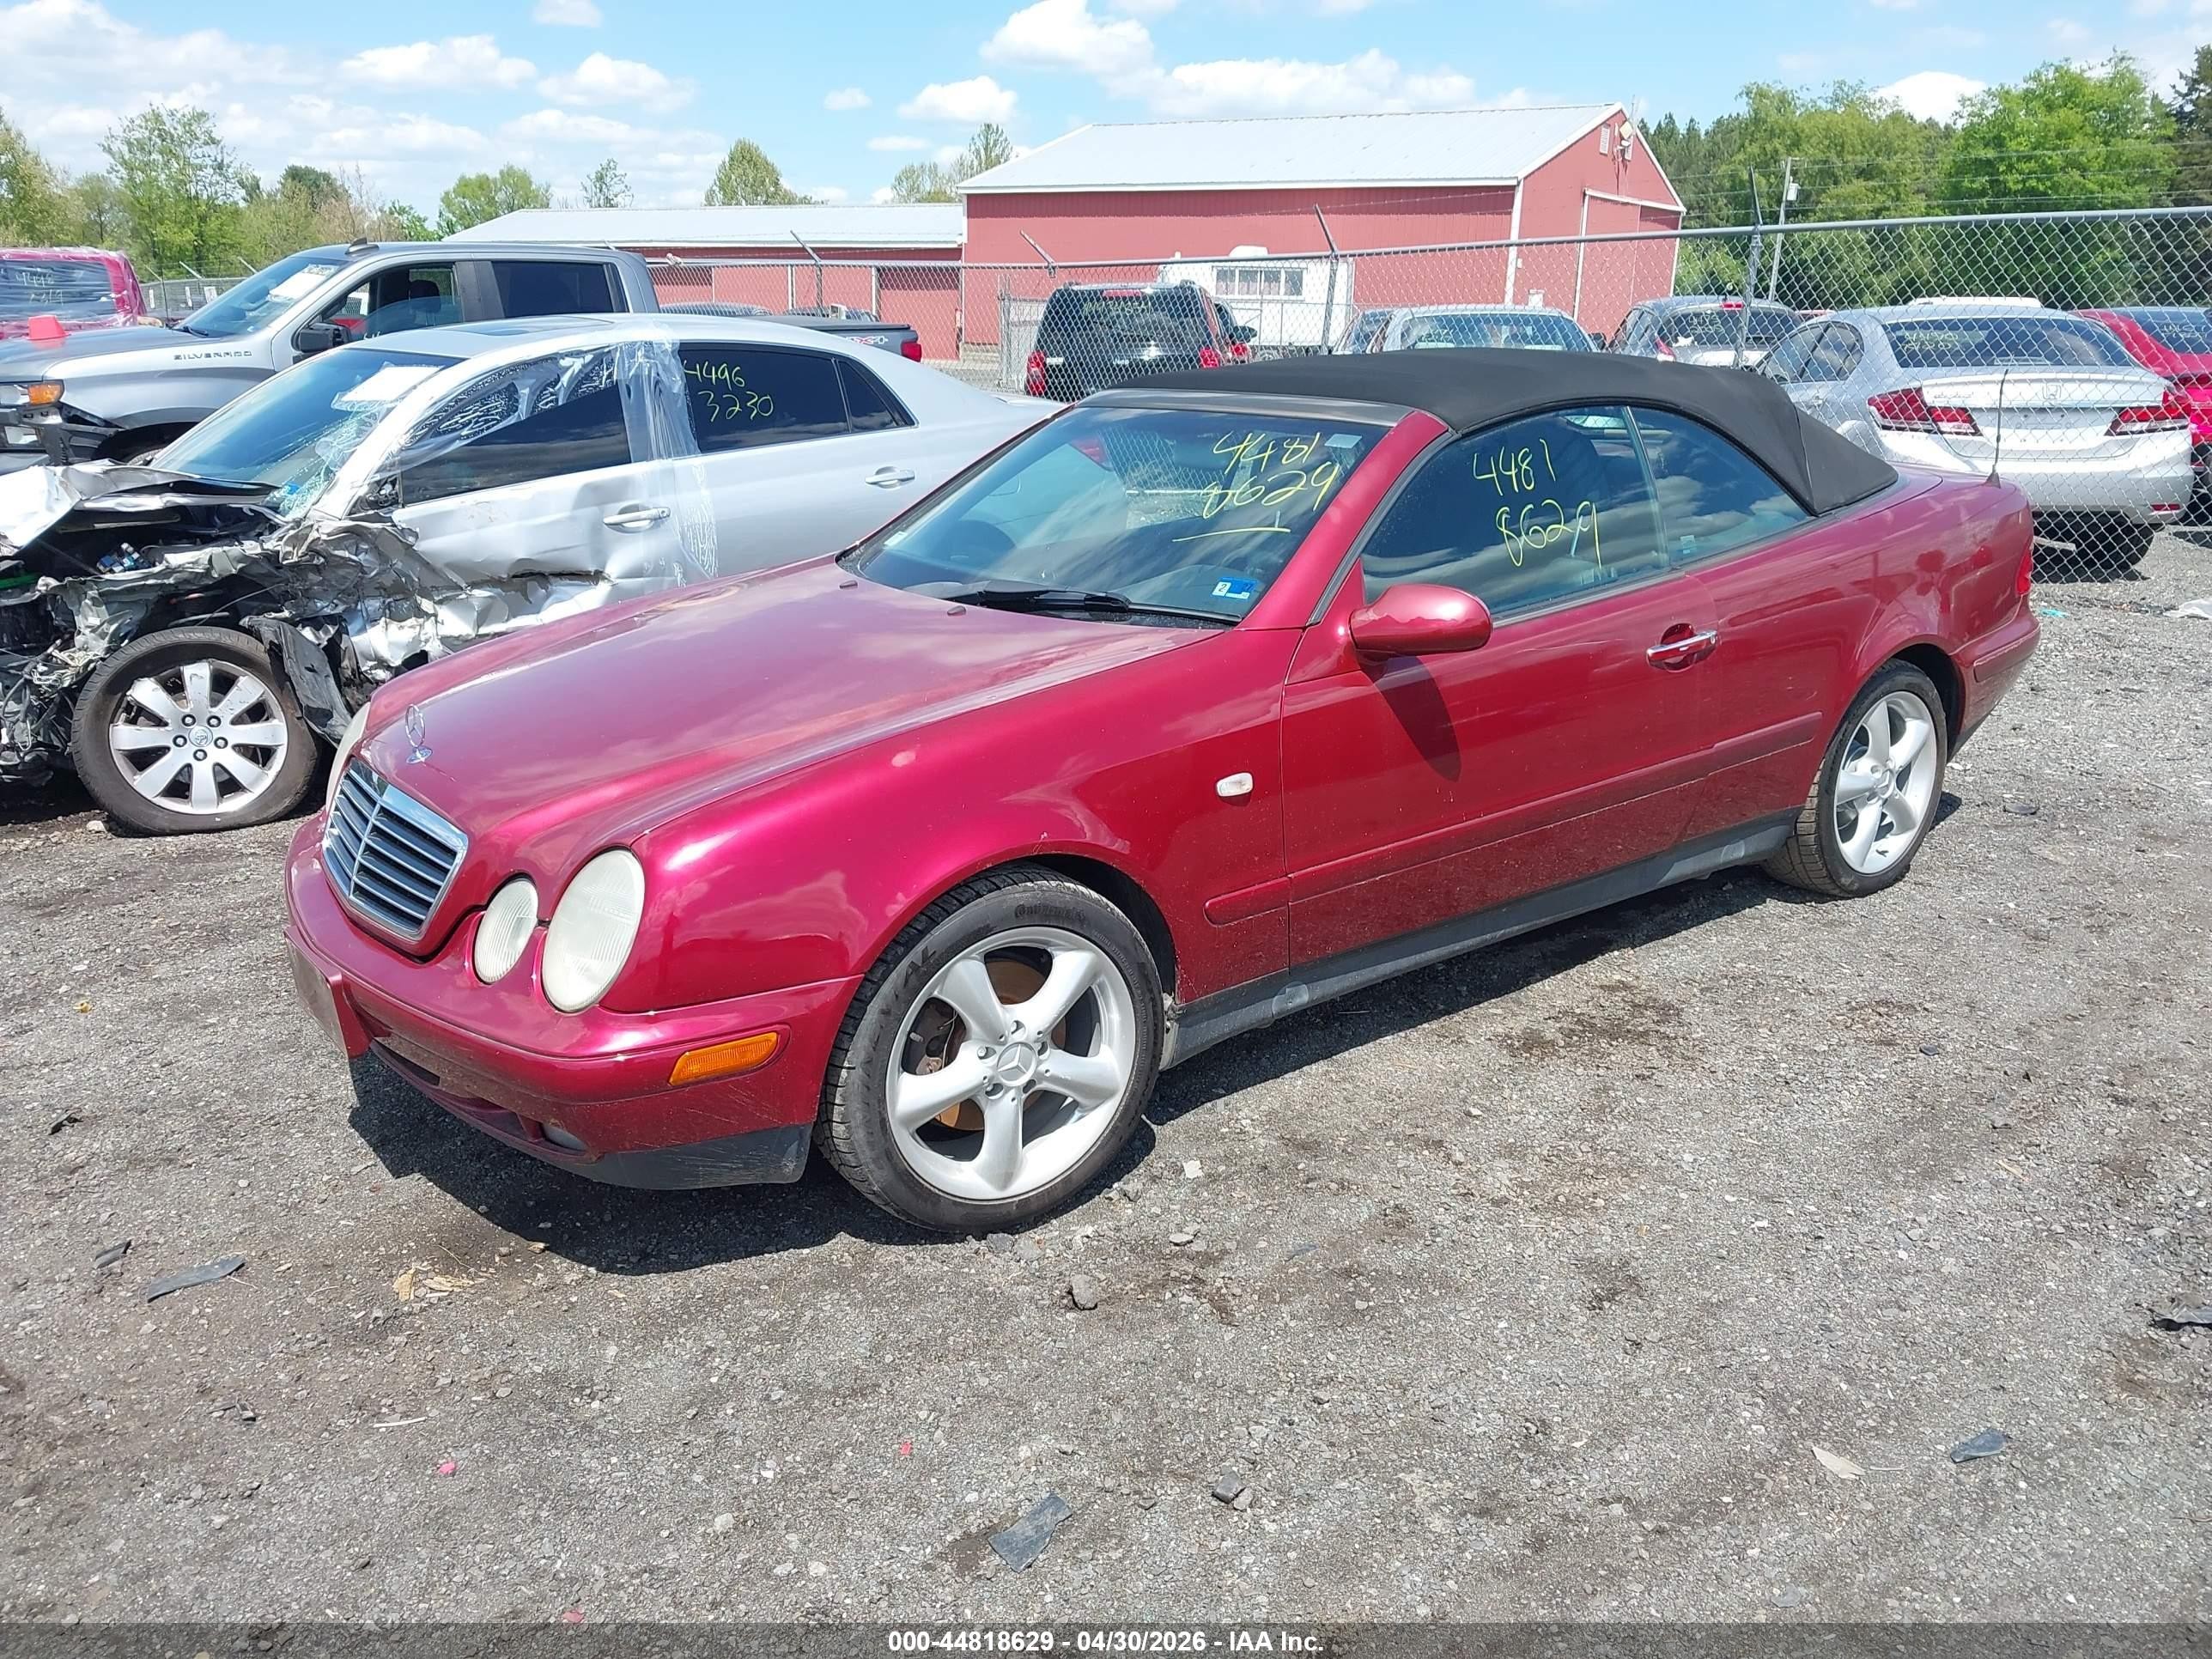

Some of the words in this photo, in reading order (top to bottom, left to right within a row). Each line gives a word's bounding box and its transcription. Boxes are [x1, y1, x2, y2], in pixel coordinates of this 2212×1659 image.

[684, 359, 745, 391] 4496
[697, 390, 774, 422] 3230
[1213, 429, 1321, 474] 4481
[1473, 438, 1557, 496] 4481
[1203, 462, 1340, 519] 8629
[1495, 499, 1601, 569] 8629
